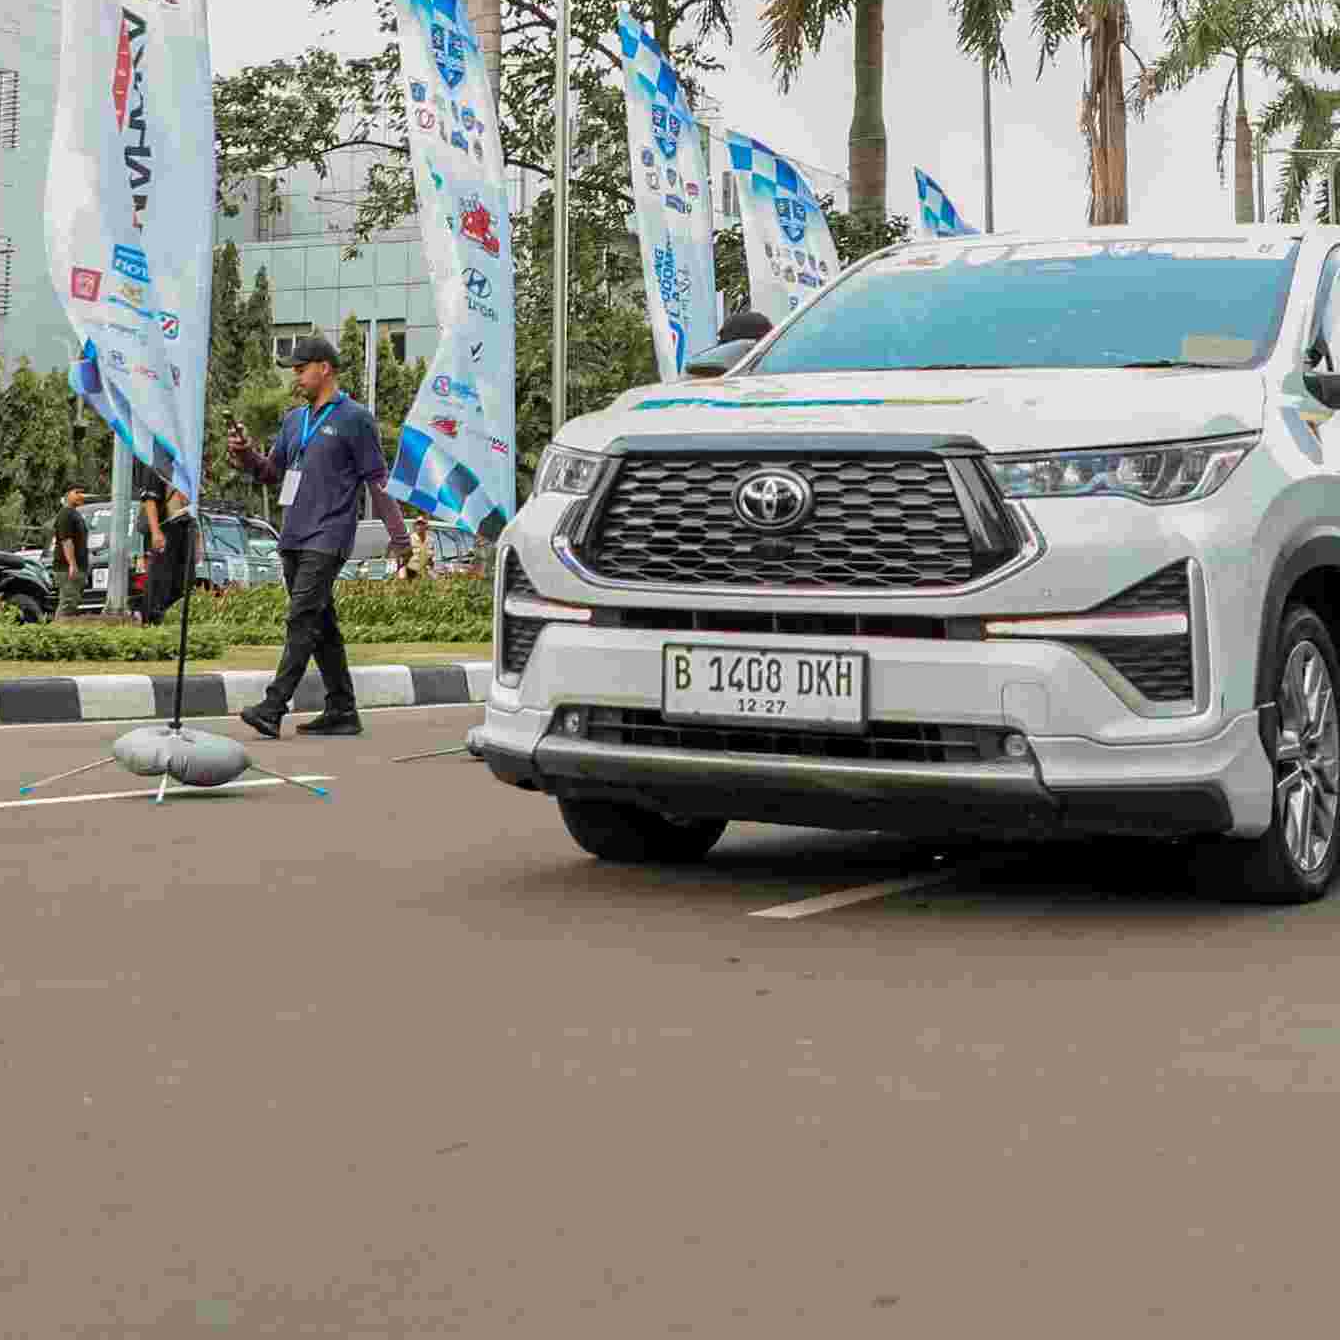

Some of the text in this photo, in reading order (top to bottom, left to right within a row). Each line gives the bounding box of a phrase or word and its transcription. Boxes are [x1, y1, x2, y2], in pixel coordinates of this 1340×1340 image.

[675, 655, 852, 697] B 1408 DKH
